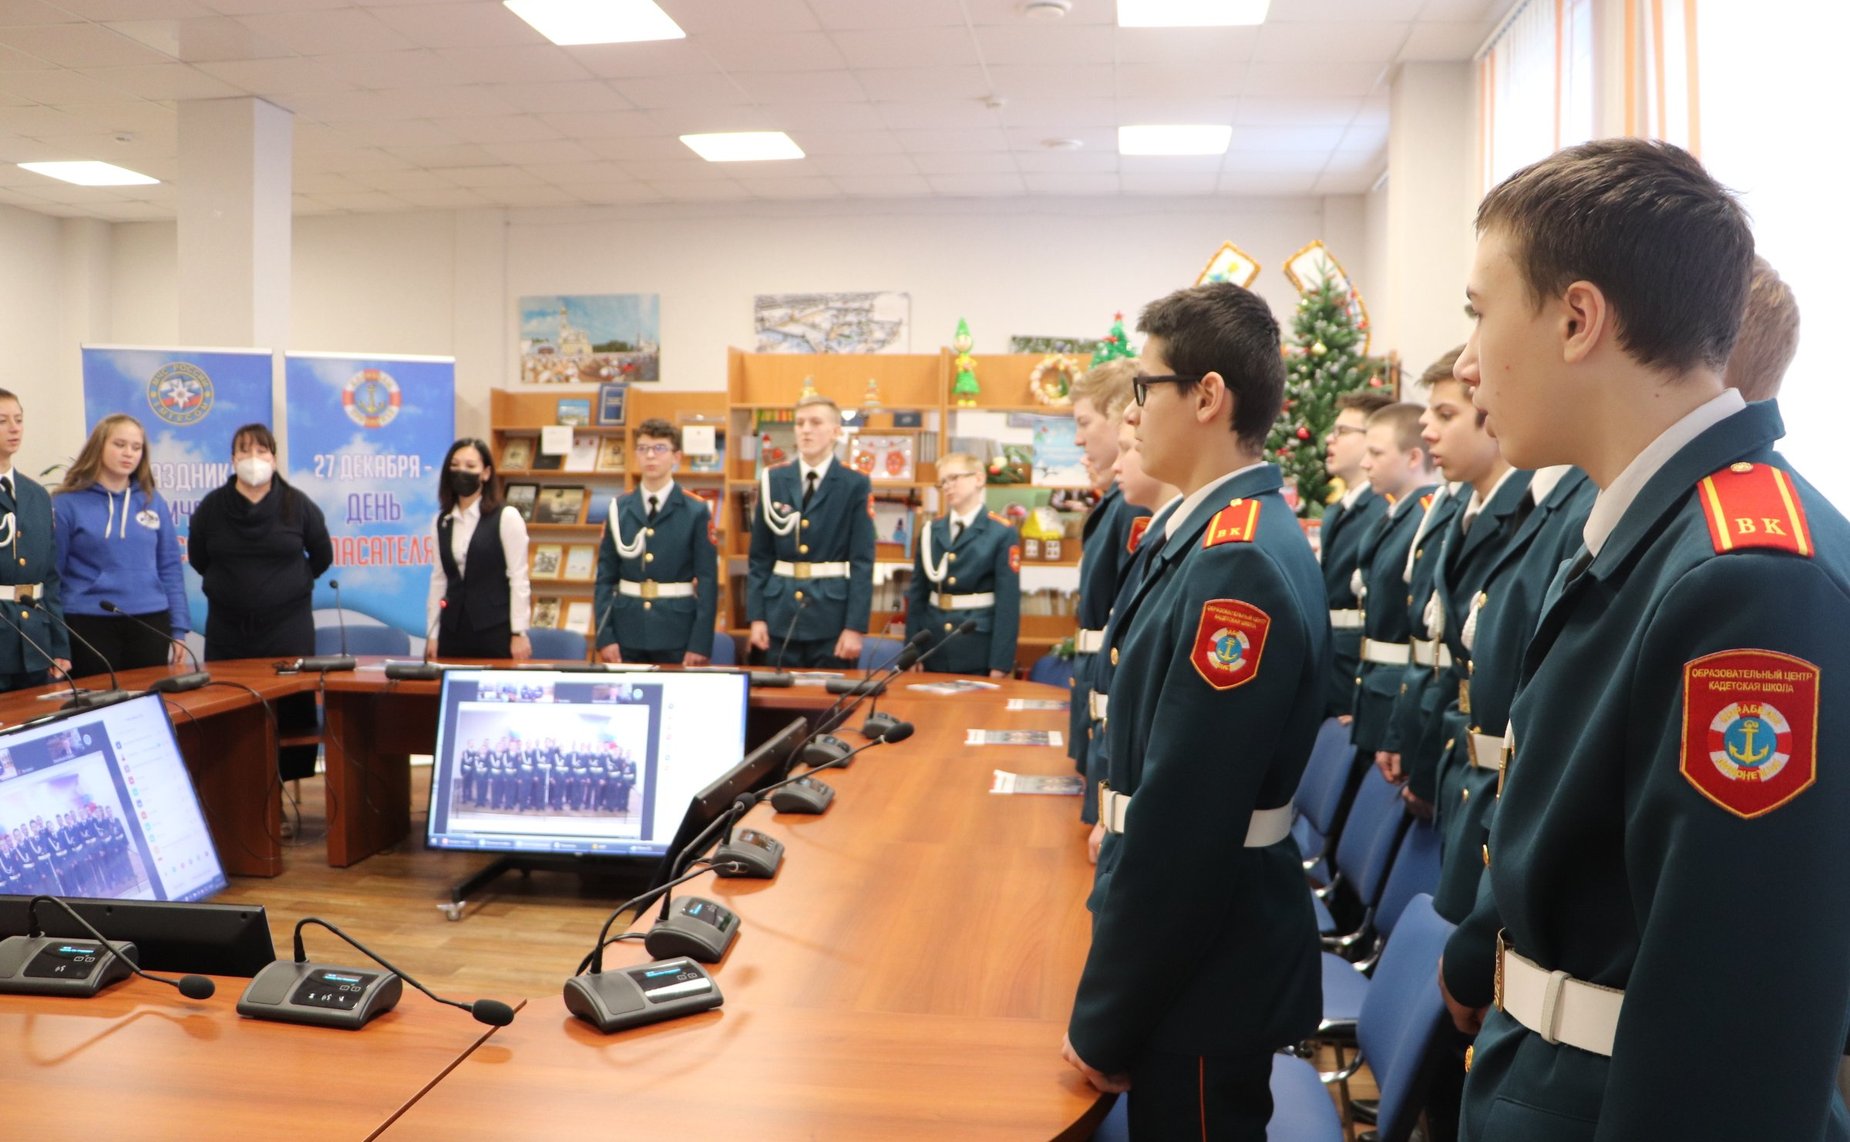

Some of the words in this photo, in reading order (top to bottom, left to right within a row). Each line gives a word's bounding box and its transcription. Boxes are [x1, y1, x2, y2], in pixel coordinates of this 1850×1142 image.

[314, 454, 335, 478] 27
[340, 454, 420, 480] ДЕКАБРЯ
[346, 493, 401, 524] ДЕНЬ
[331, 536, 433, 566] ПАСАТЕЛЯ
[1691, 668, 1782, 680] ОБРАЗОВАТЕЛЬНЫЙ
[1784, 671, 1813, 682] ЦЕНТР
[1708, 681, 1761, 692] КАДЕТСКАЯ
[1762, 682, 1794, 693] ШКОЛА
